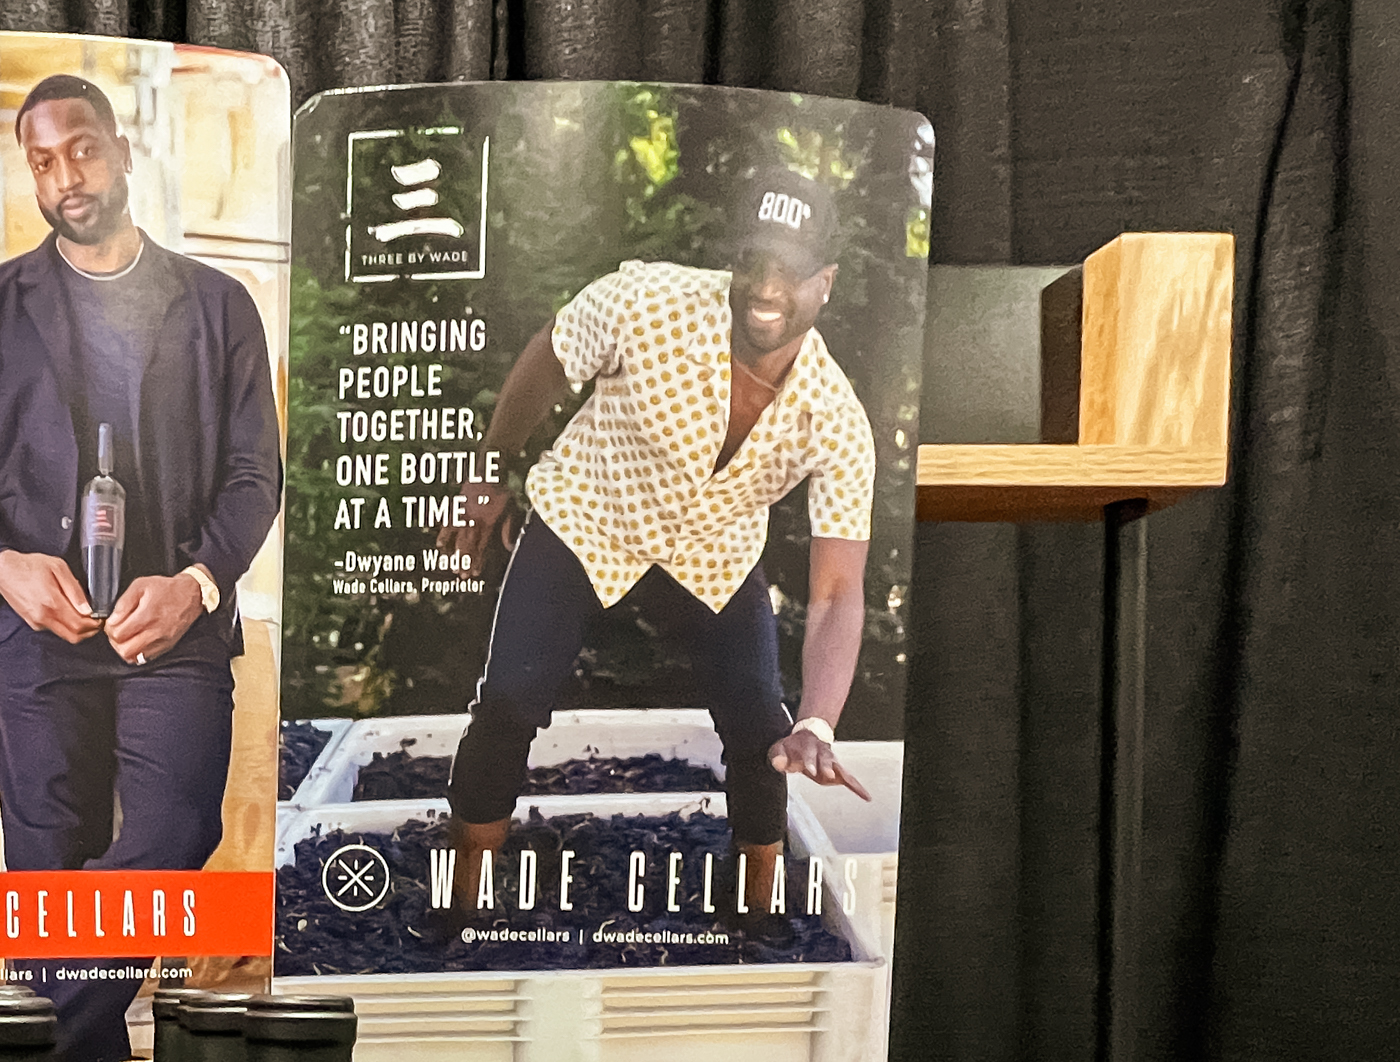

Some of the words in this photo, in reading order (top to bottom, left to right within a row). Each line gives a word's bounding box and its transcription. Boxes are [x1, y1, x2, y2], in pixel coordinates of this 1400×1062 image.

[361, 253, 403, 265] THREE
[408, 252, 425, 264] BY
[430, 250, 468, 263] WADE
[338, 364, 442, 400] PEOPLE
[336, 408, 483, 443] TOGETHER,
[335, 453, 390, 487] ONE
[401, 451, 500, 485] BOTTLE
[334, 497, 365, 530] AT
[374, 497, 392, 529] A
[422, 549, 471, 571] Wade
[333, 579, 366, 594] Wade
[421, 577, 485, 596] Proprietor
[429, 848, 576, 911] WADE
[627, 850, 858, 916] CELLARS
[5, 889, 197, 939] CELLARS
[461, 928, 570, 944] @wadecellars
[592, 928, 730, 945] dwadecellars.com
[55, 965, 193, 982] dwadecellars.com
